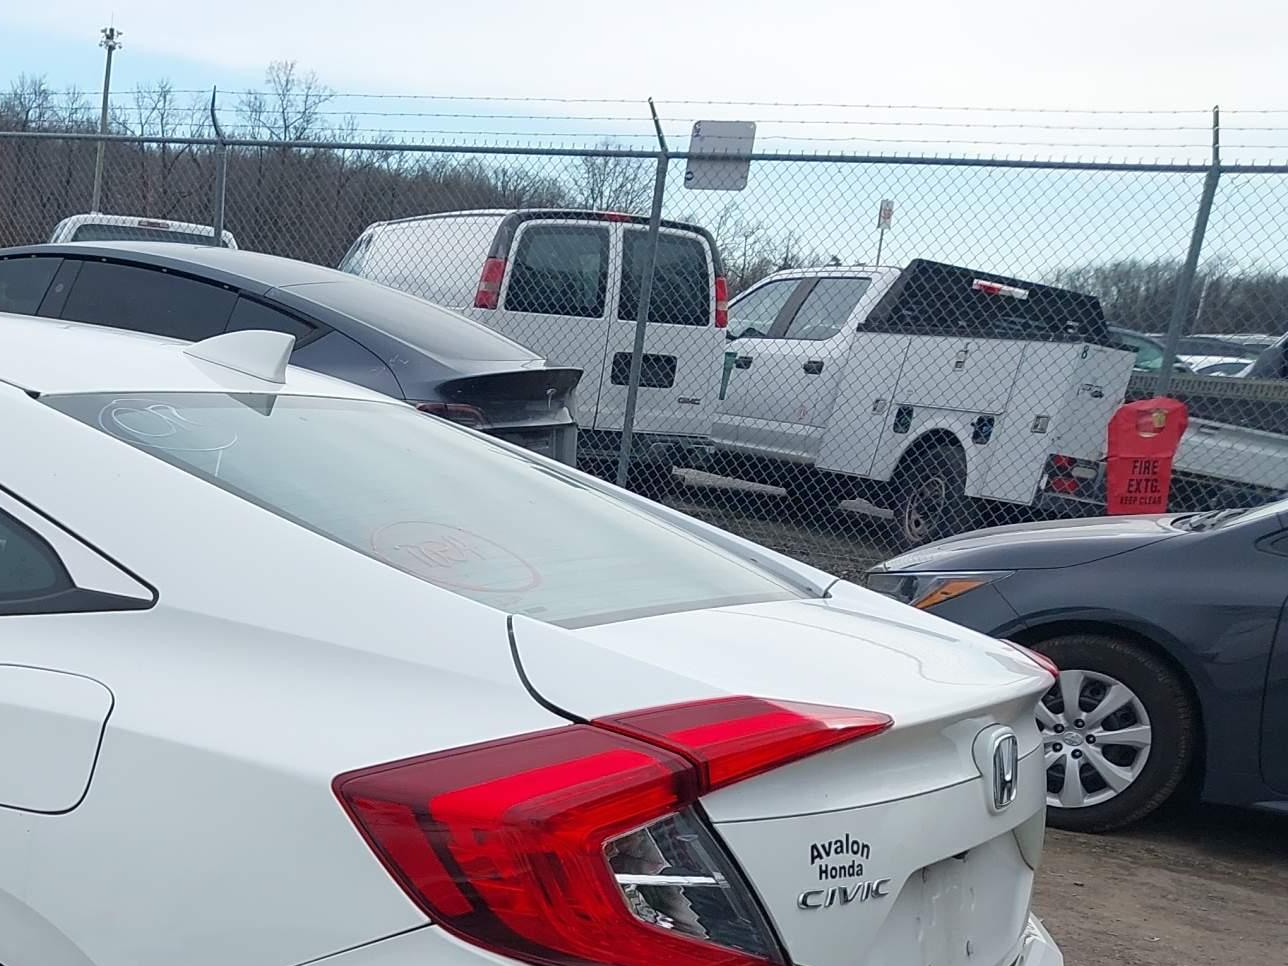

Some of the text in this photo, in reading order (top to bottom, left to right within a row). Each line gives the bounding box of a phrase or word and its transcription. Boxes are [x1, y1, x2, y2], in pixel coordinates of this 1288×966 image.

[1132, 459, 1160, 475] FIRE
[1127, 479, 1161, 494] EXTG.
[1120, 496, 1162, 505] KEEP CLEAR
[810, 833, 871, 865] Avalon
[818, 859, 864, 880] Honda
[797, 879, 892, 910] CIVIC
